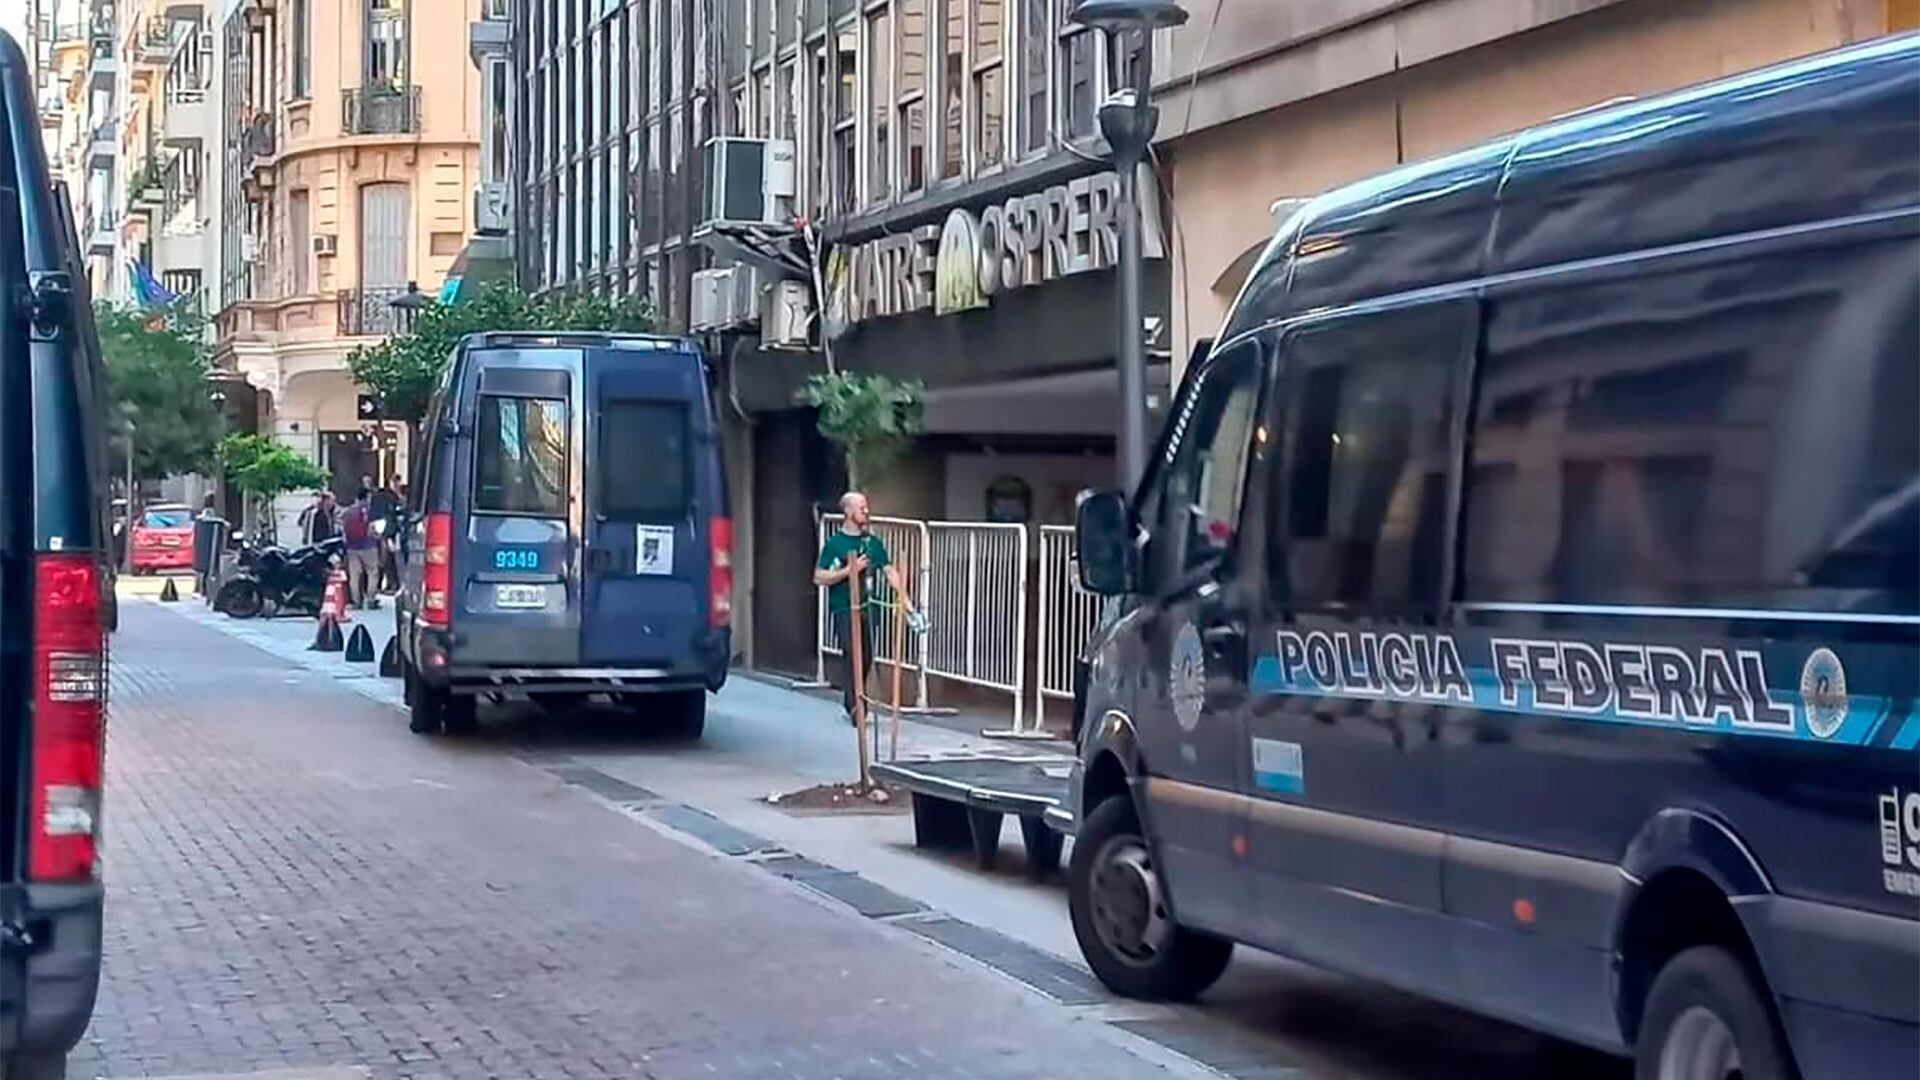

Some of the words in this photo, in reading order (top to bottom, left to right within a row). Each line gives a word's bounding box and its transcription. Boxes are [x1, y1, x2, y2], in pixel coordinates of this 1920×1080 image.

[496, 550, 538, 569] 9349
[1277, 630, 1474, 702] POLICIA
[1490, 638, 1796, 732] FEDERAL
